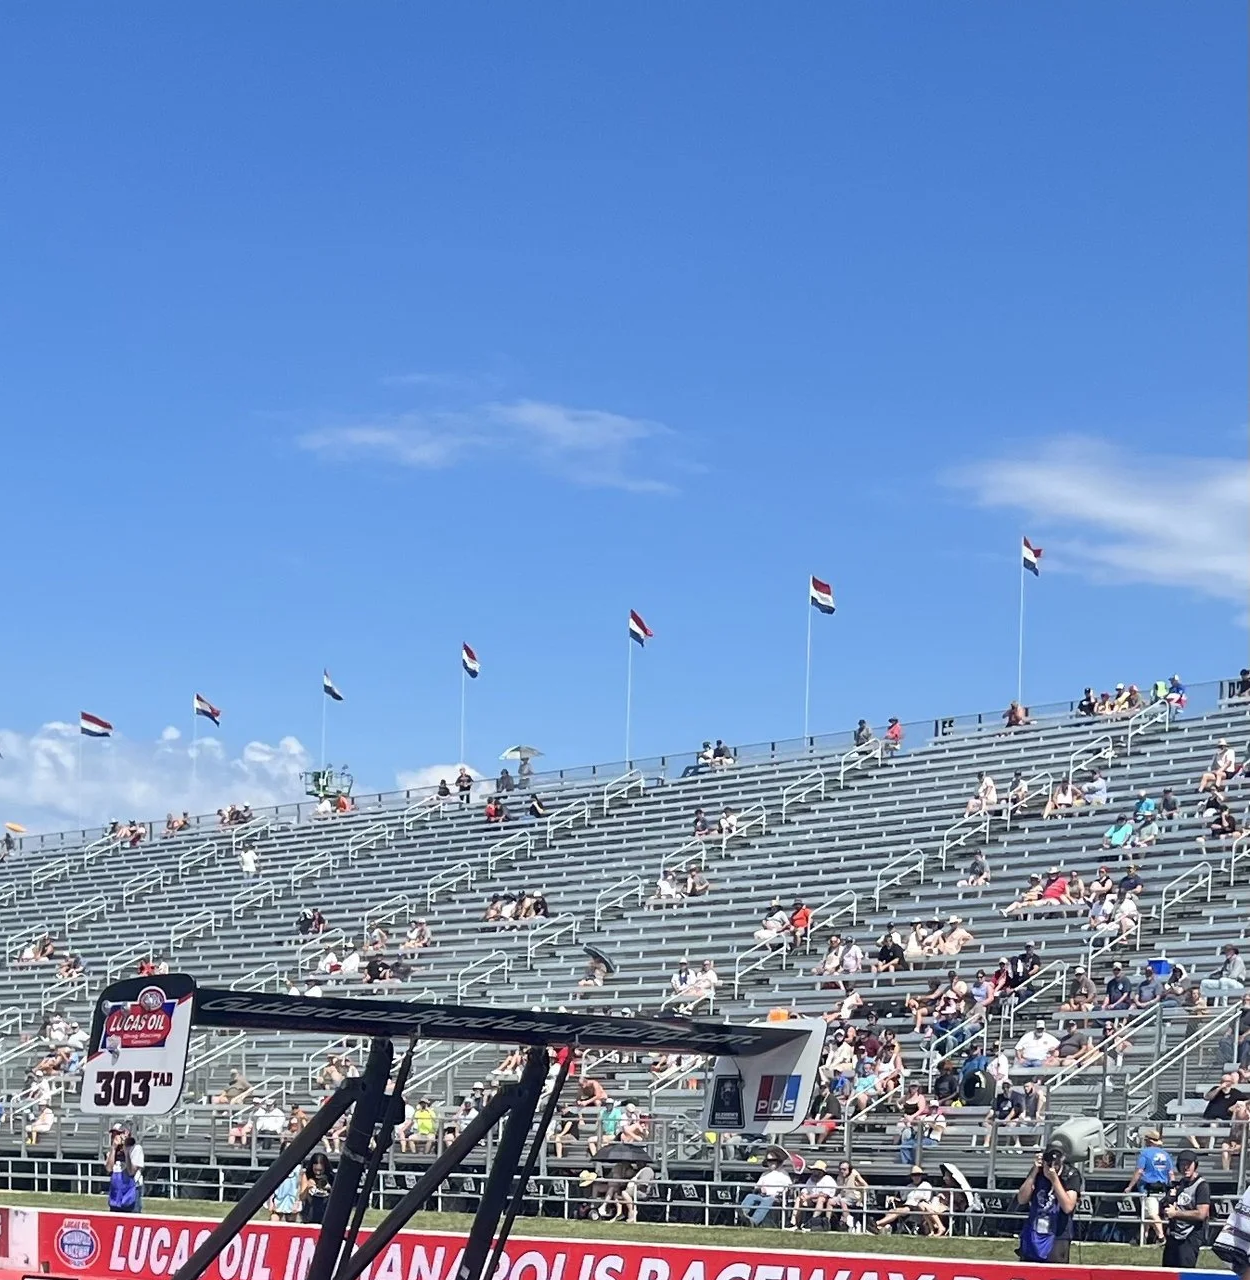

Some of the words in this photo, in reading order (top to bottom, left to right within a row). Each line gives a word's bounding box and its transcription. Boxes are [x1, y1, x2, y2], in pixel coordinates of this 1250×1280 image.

[109, 1014, 146, 1031] LUCAS
[147, 1014, 165, 1031] OIL
[94, 1071, 152, 1106] 303
[153, 1073, 173, 1086] TAD
[757, 1100, 795, 1113] PDS
[219, 1233, 271, 1280] OIL
